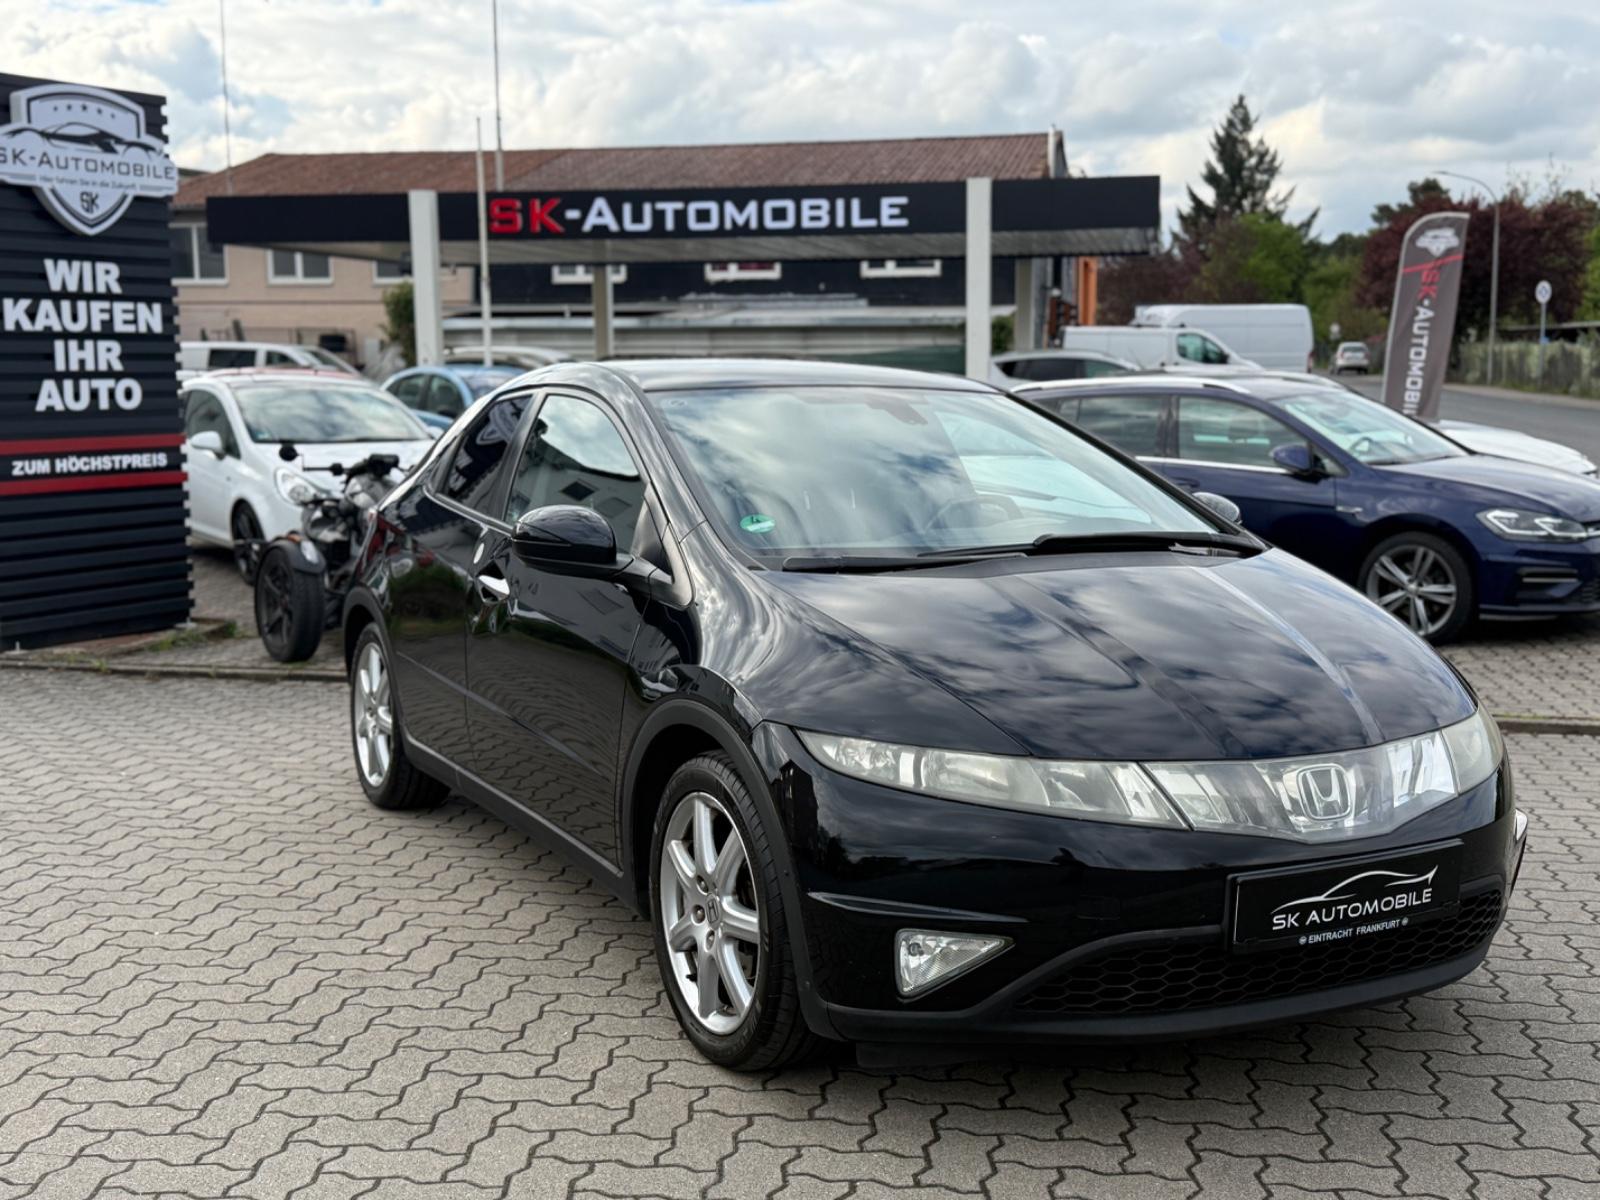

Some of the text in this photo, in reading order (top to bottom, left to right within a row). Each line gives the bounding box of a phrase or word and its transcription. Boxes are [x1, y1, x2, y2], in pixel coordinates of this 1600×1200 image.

[489, 196, 909, 233] SK-AUTOMOBILE
[43, 258, 122, 294] WIR
[3, 297, 163, 334] KAUFEN
[54, 339, 124, 372] IHR
[35, 378, 143, 412] AUTO
[11, 452, 168, 476] ZUM HÖCHSTPREIS
[1272, 887, 1433, 931] SK AUTOMOBILE
[1308, 918, 1401, 945] EINTRACHT FRANKFURT
